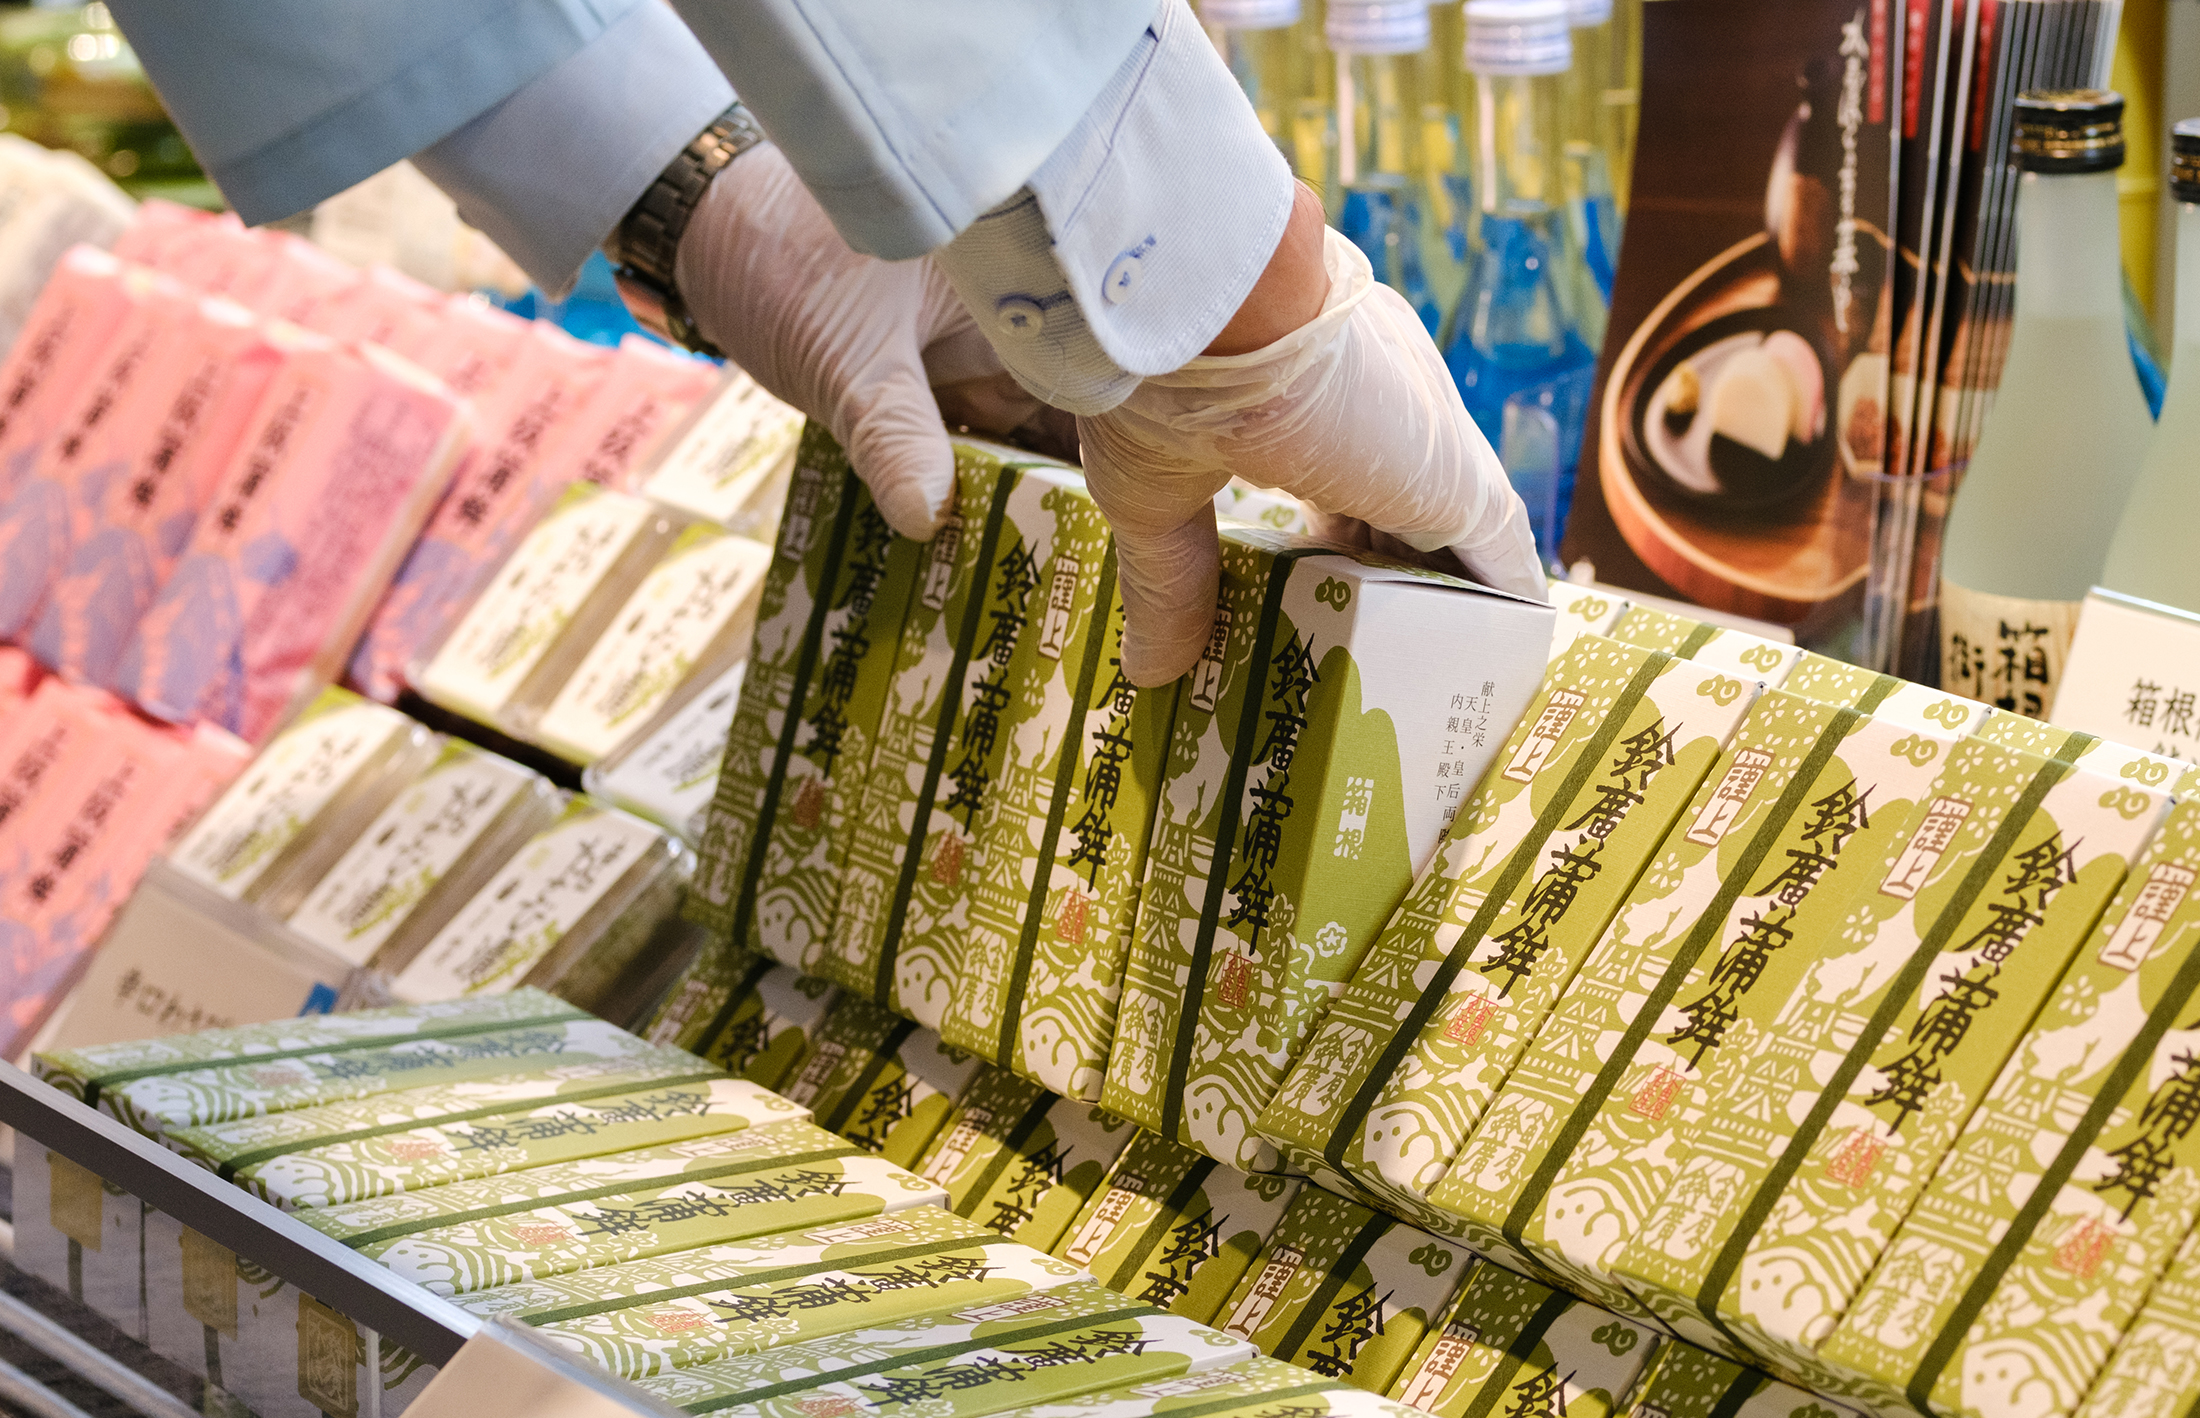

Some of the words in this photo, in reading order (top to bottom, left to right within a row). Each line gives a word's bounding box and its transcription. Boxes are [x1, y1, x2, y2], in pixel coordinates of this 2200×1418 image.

[1042, 557, 1079, 658] 謹上
[945, 536, 1042, 836] 鈴廣蒲鉾
[1472, 680, 1495, 748] 献上之栄
[2122, 676, 2200, 741] 箱根
[1068, 604, 1133, 893] 廣蒲鉾
[1434, 693, 1464, 801] 内親王殿下
[1508, 691, 1583, 776] 謹上
[1226, 627, 1322, 957] 鈴廣蒲鉾
[1691, 752, 1771, 840] 謹上
[1480, 716, 1684, 1000] 鈴廣蒲鉾
[1885, 800, 1970, 893] 謹上
[1667, 777, 1877, 1072] 鈴廣蒲鉾
[2107, 866, 2195, 962] 謹上
[1865, 830, 2086, 1137] 鈴廣蒲鉾
[574, 1168, 862, 1236] 鈴廣蒲鉾
[1069, 1174, 1139, 1258] 謹上
[708, 1255, 1005, 1323] 鈴廣蒲鉾
[1228, 1247, 1303, 1335] 謹上
[858, 1329, 1164, 1407] 鈴廣蒲鉾
